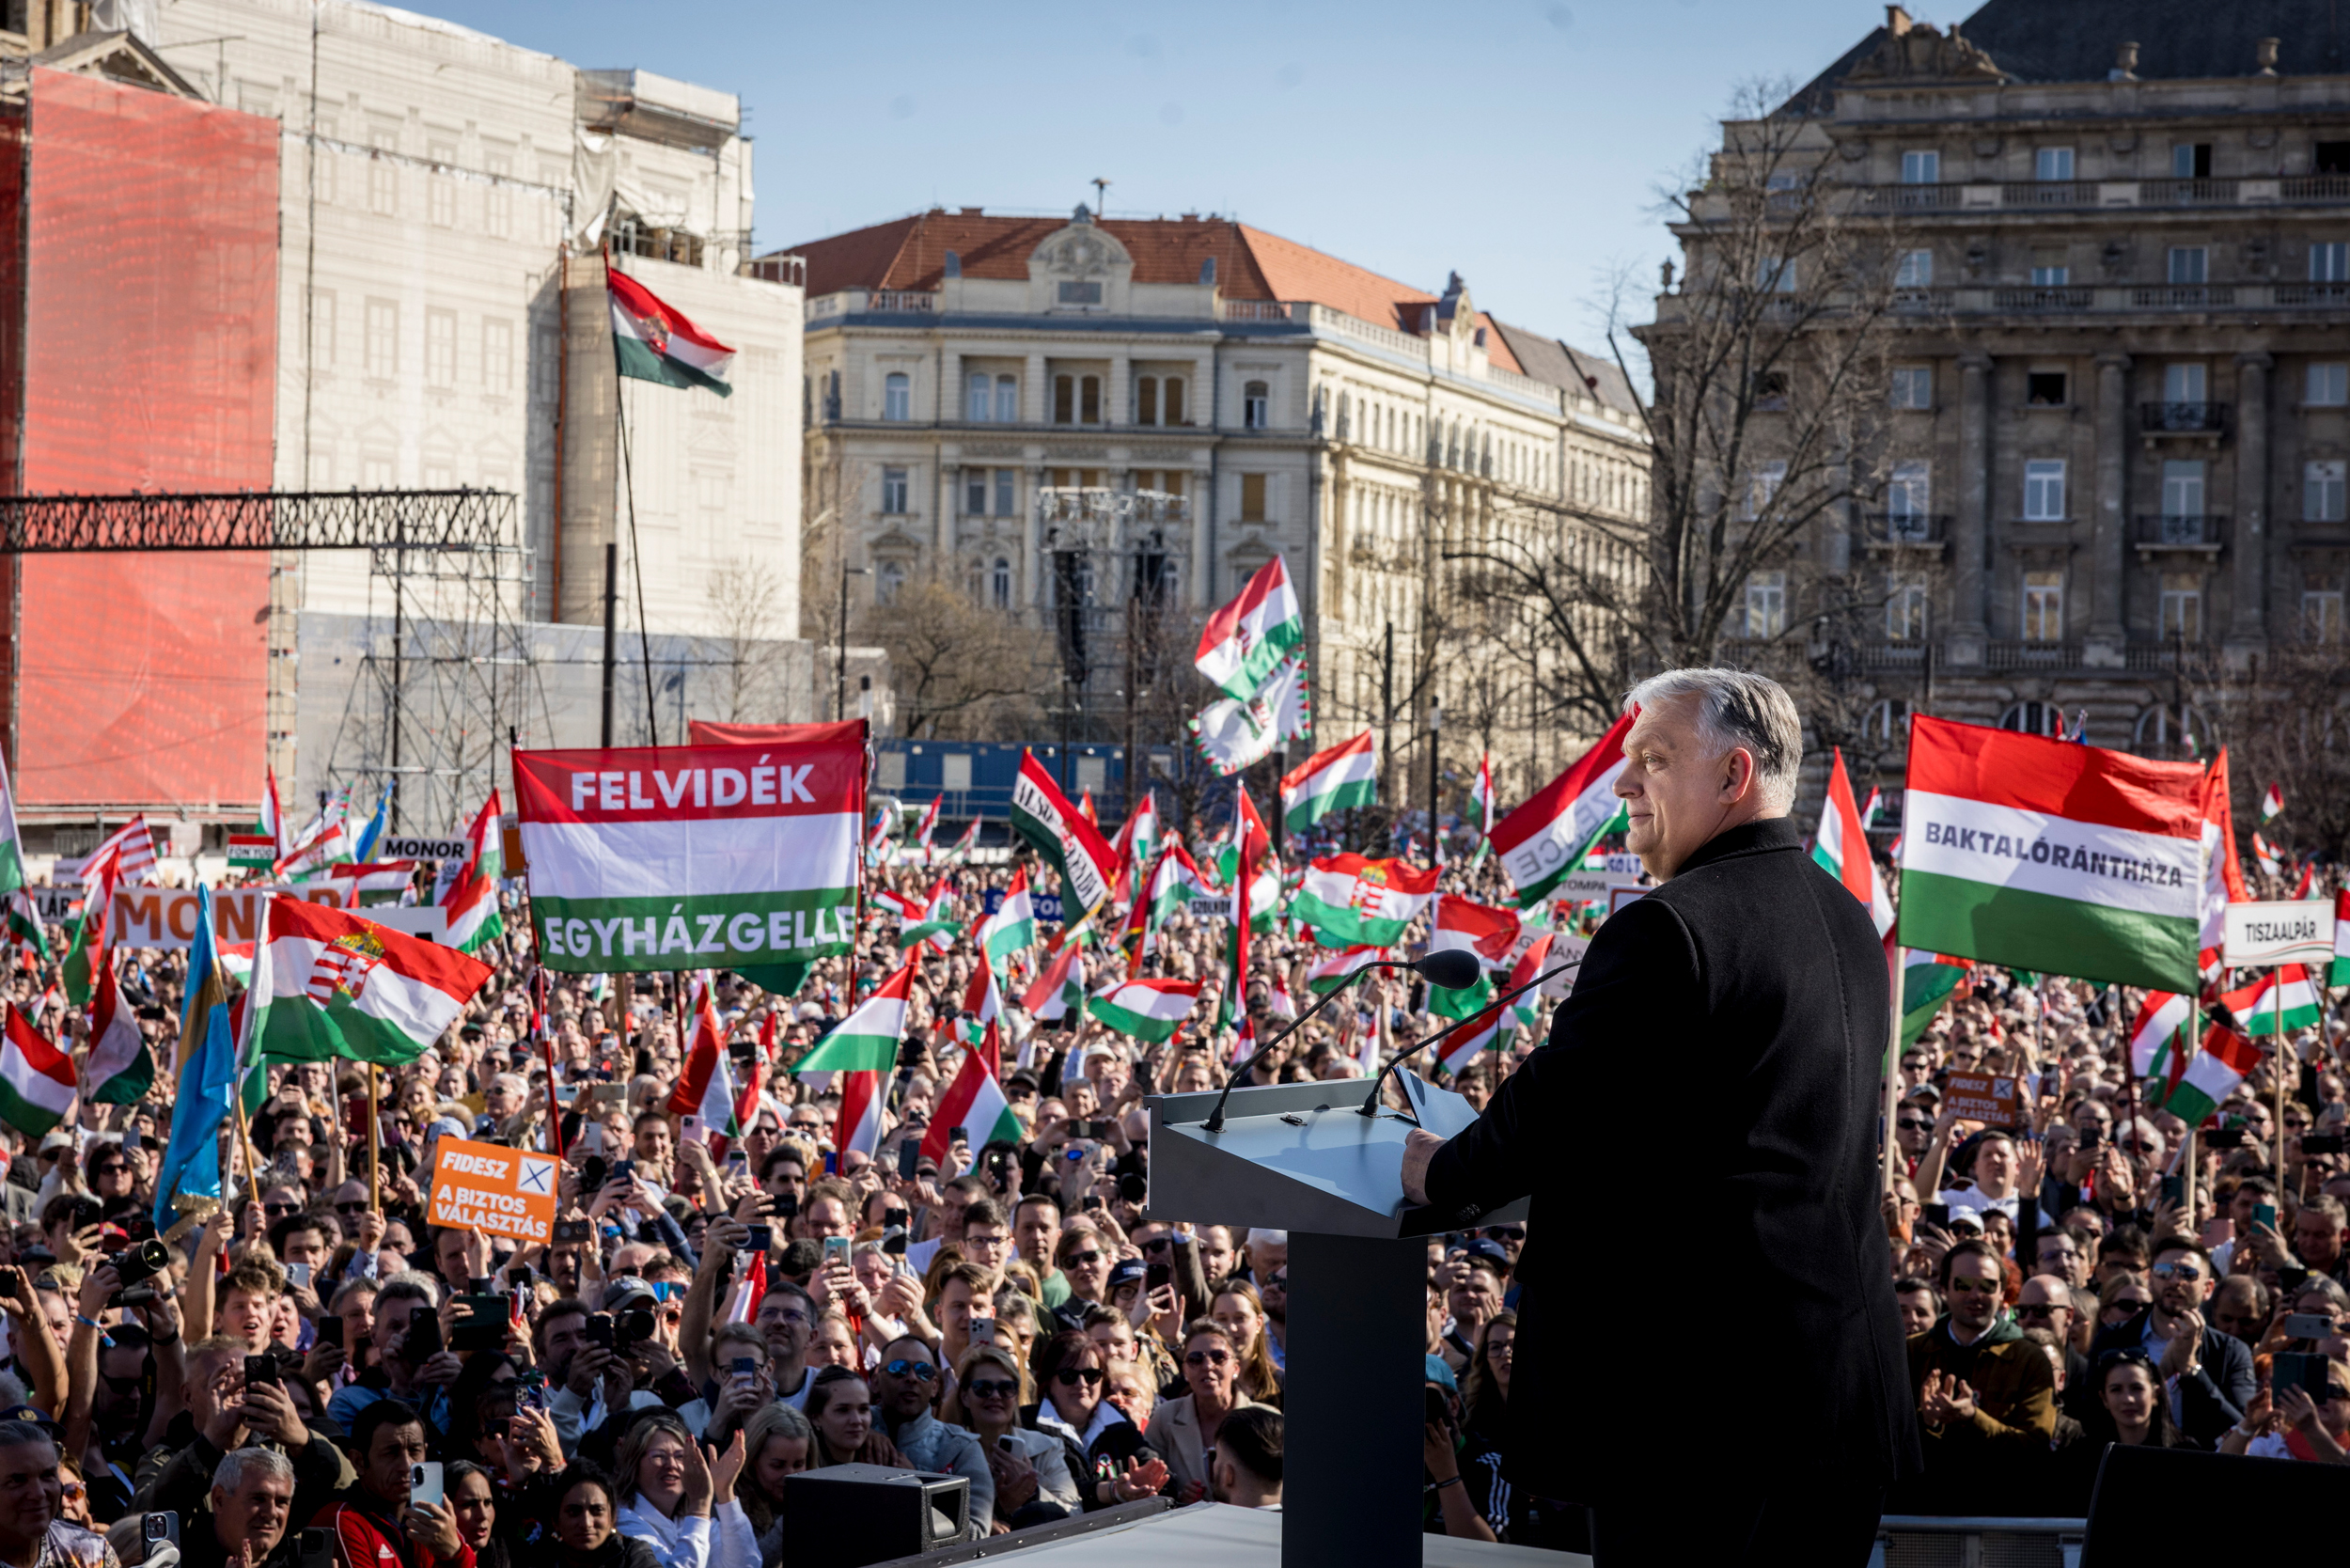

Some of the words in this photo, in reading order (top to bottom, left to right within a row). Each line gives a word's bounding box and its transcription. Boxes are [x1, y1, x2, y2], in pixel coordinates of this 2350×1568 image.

[572, 754, 816, 811] FELVIDÉK
[384, 839, 465, 859] MONOR
[1925, 822, 2184, 888] BAKTALÓRÁNTHÁZA
[1561, 879, 1607, 891] TOMPA
[113, 886, 341, 941] MON
[544, 902, 856, 958] EGYHÁZGELLE
[2245, 917, 2316, 942] TISZAALPÁR
[1950, 1077, 1988, 1091] FIDESZ
[441, 1151, 509, 1180] FIDESZ
[436, 1184, 453, 1202] A
[455, 1186, 526, 1215] BIZTOS
[435, 1201, 548, 1239] VÁLASZTÁS
